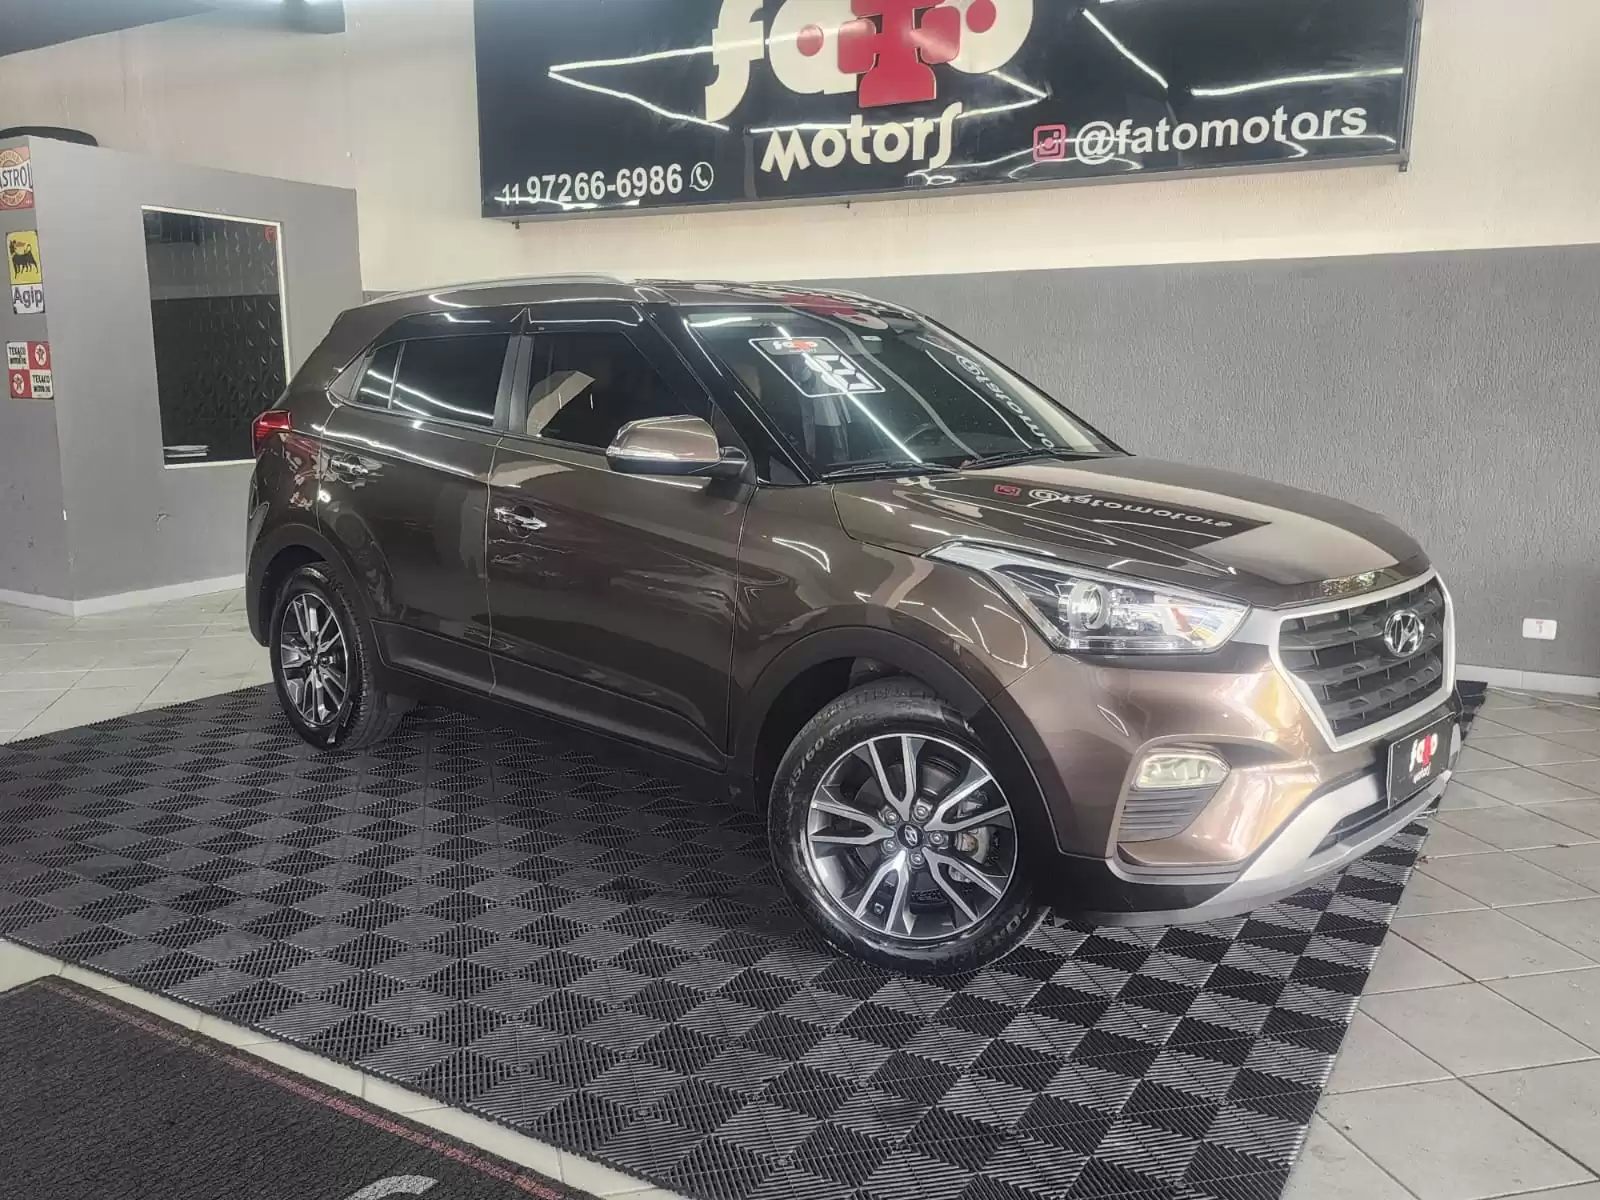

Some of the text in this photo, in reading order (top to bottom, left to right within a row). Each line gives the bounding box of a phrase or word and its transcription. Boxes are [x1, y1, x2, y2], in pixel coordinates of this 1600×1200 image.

[1075, 105, 1367, 165] @fatomotors
[502, 163, 683, 205] 11 97266-6986
[13, 286, 43, 308] Agip
